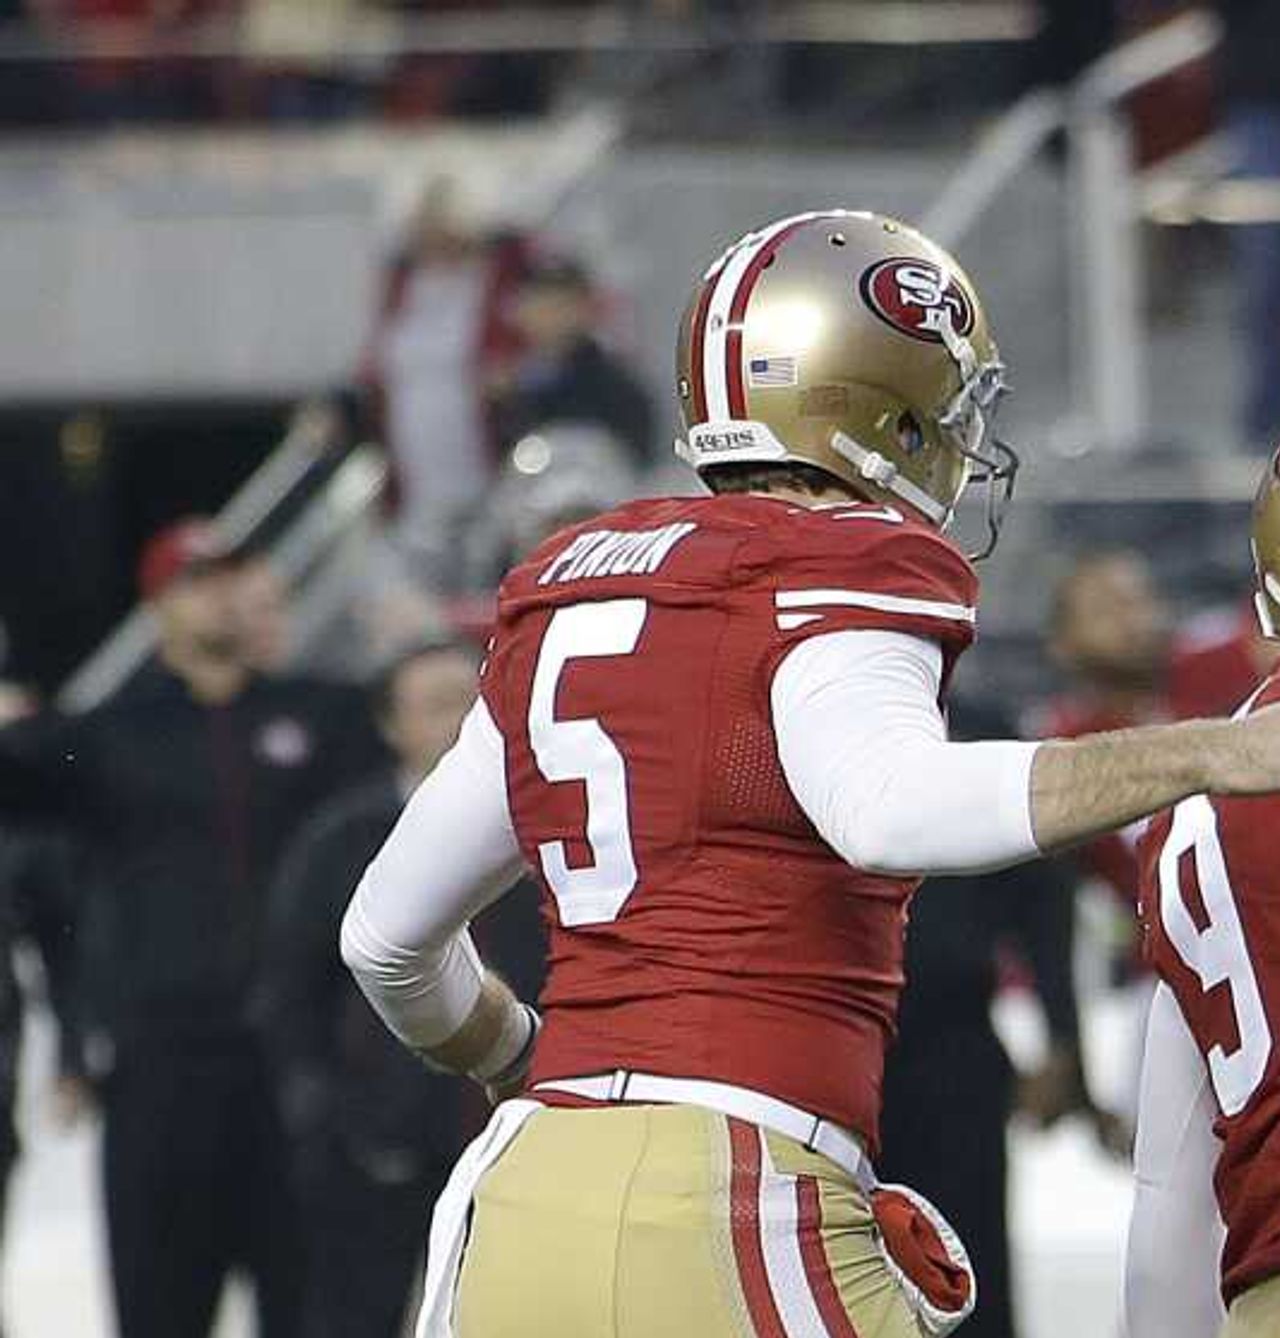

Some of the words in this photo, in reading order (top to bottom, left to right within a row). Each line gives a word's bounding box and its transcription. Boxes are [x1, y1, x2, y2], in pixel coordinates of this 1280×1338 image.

[694, 430, 756, 451] 49ERS
[537, 522, 698, 586] PINION
[527, 597, 647, 927] 5
[1157, 792, 1272, 1117] 9
